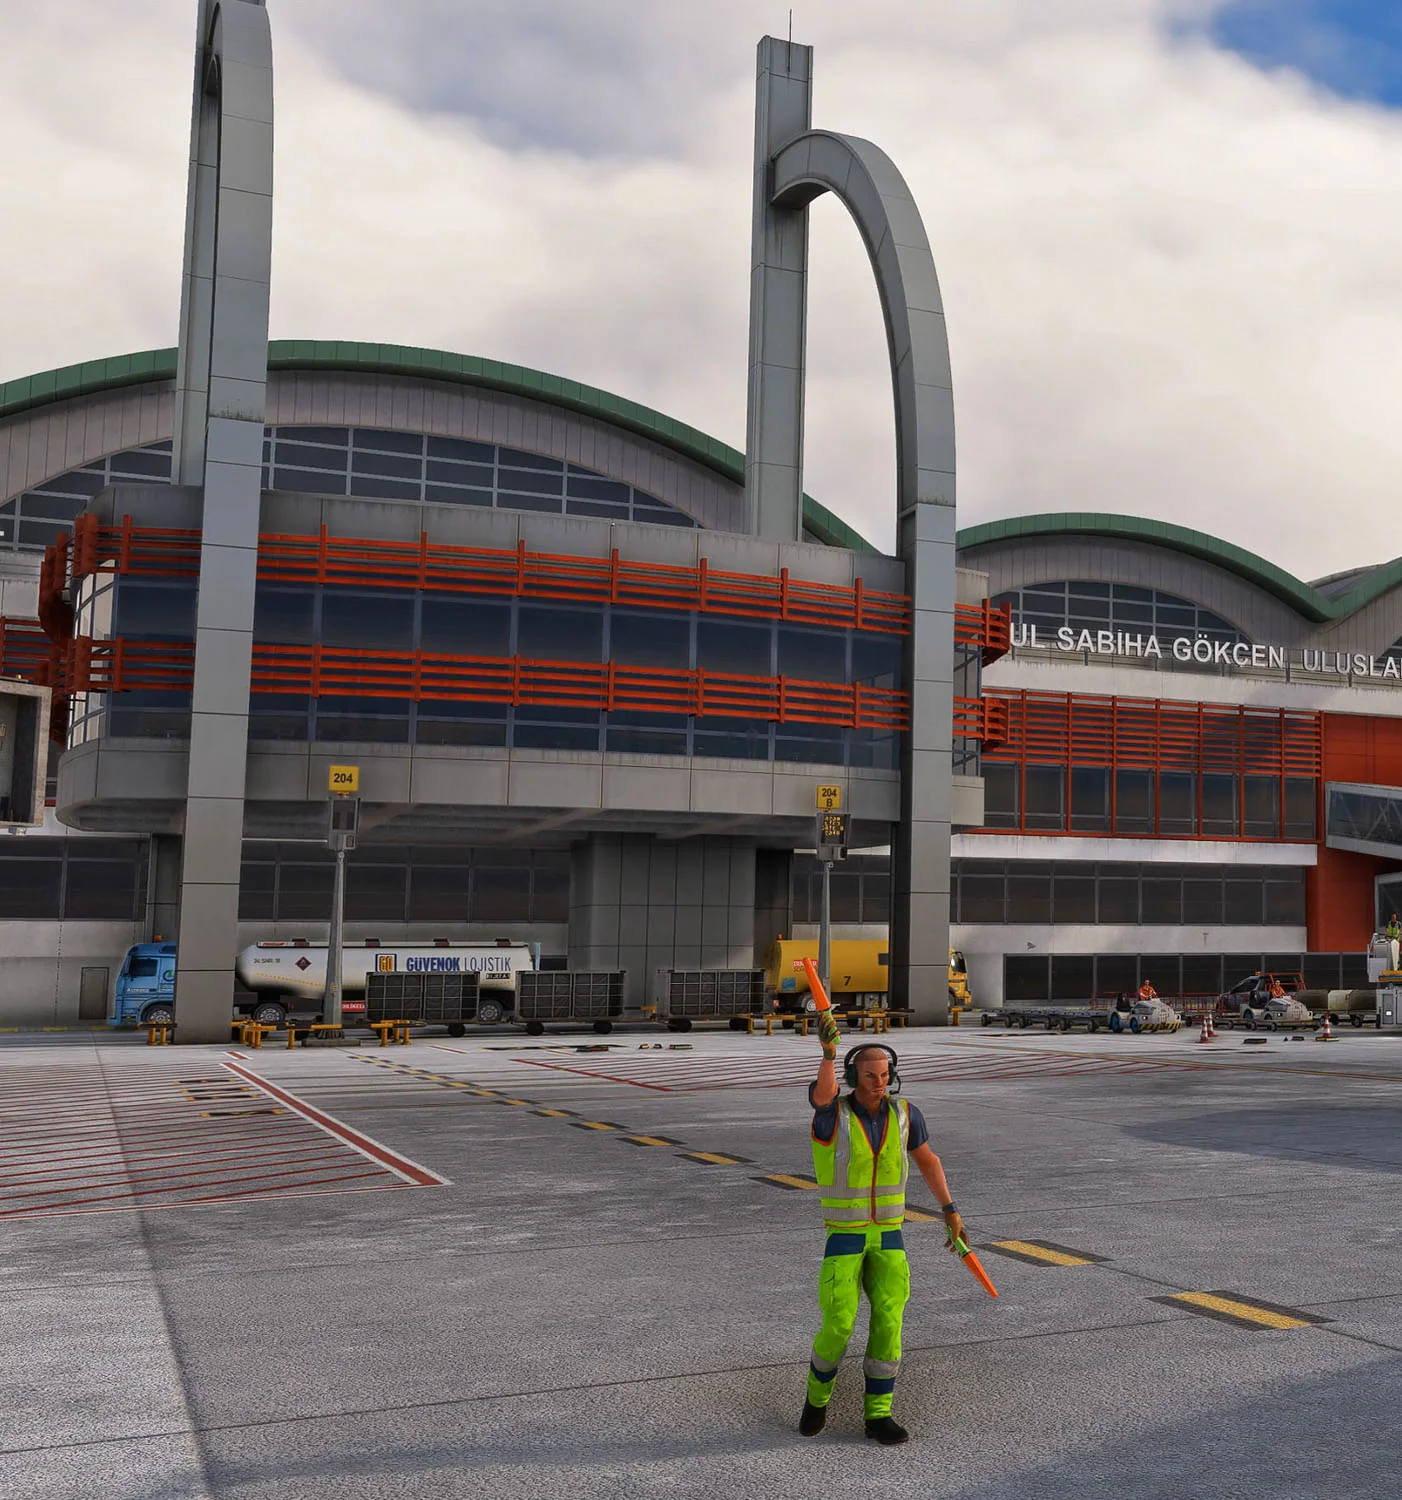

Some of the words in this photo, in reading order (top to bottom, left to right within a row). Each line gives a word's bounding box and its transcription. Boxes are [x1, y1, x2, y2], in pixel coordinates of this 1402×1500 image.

[1057, 626, 1162, 659] SABİHA
[1173, 634, 1284, 668] GÖKÇEN
[333, 773, 353, 784] 204
[822, 788, 837, 797] 204
[826, 798, 833, 808] B
[406, 956, 461, 972] GÜVENOK
[843, 975, 852, 987] 7
